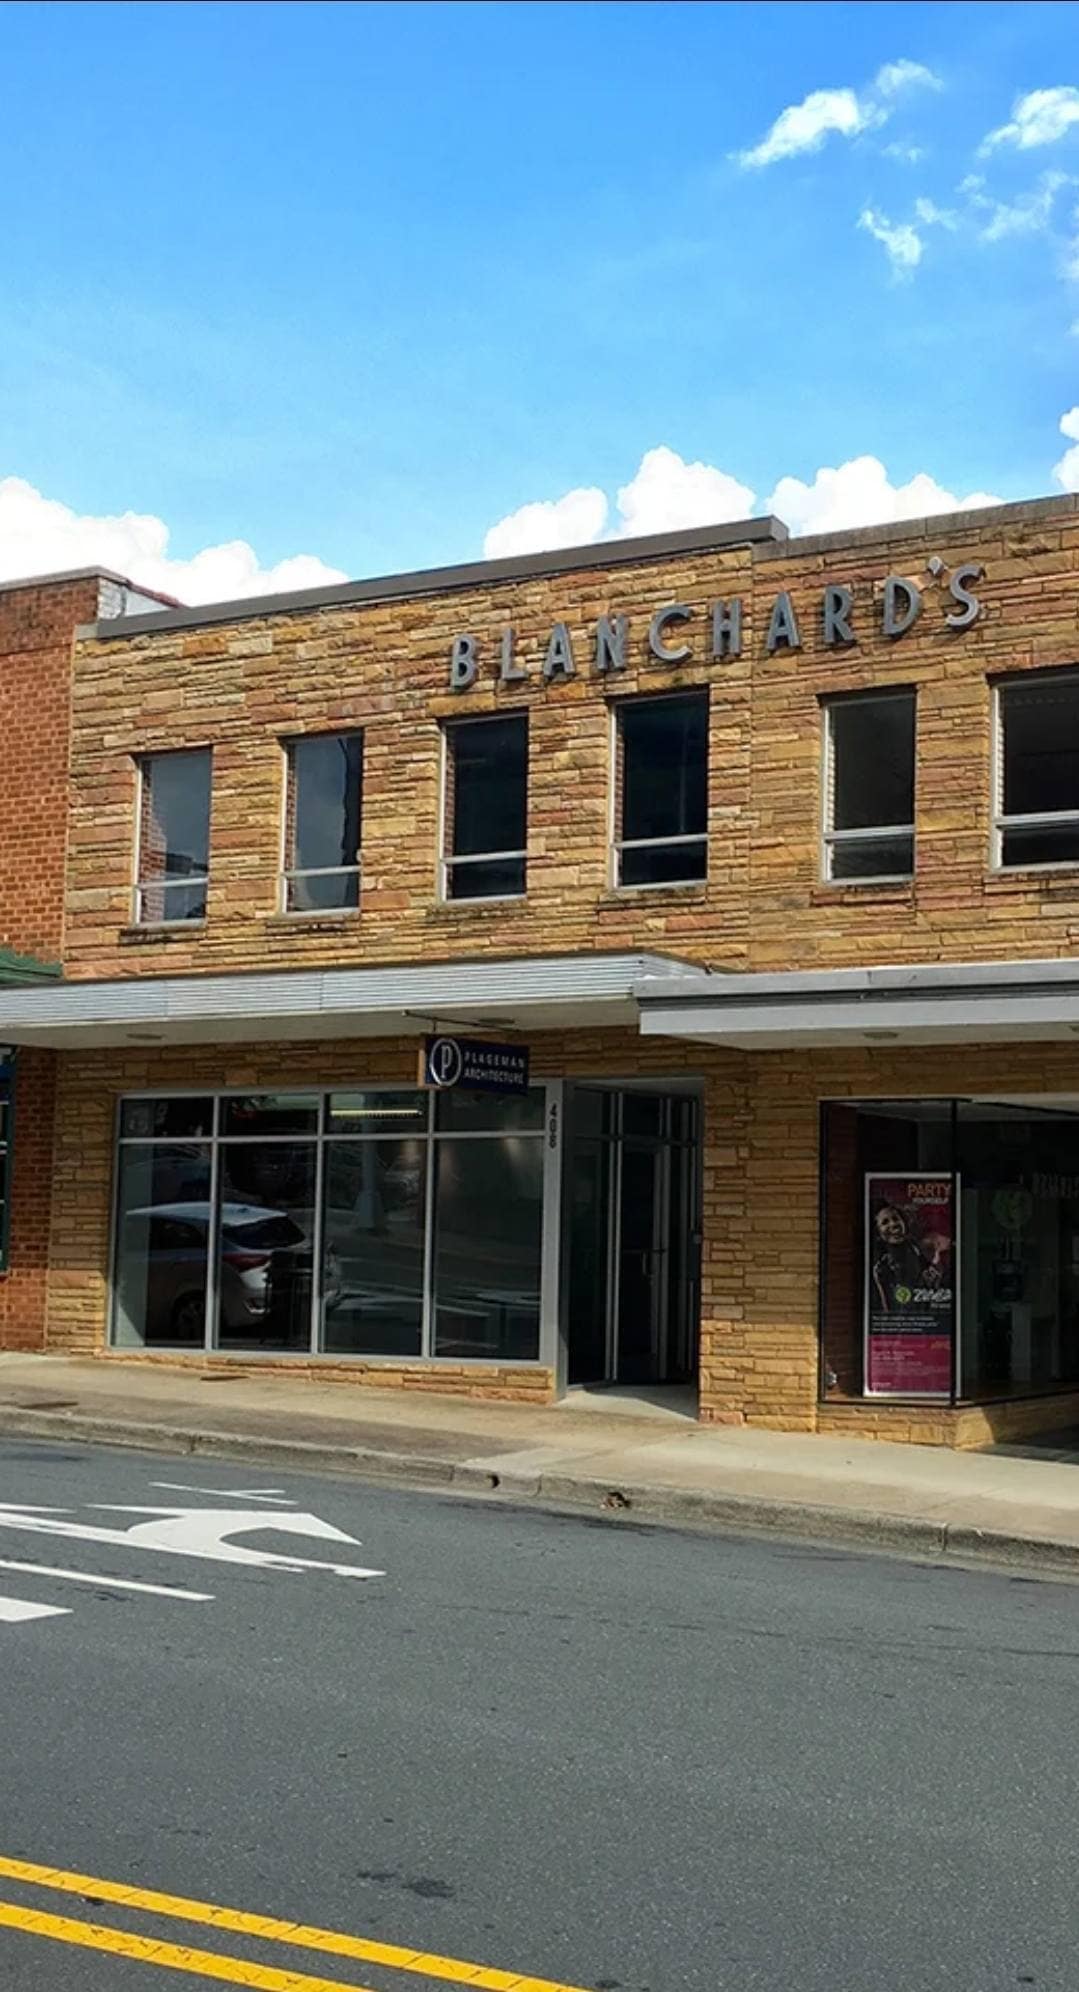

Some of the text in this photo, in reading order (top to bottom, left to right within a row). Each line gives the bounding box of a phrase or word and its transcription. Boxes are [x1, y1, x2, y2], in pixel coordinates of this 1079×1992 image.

[449, 557, 986, 689] BLANCHARD'S
[464, 1067, 525, 1084] ARCHITECTURE
[549, 1103, 557, 1149] 408
[908, 1183, 952, 1198] PARTY
